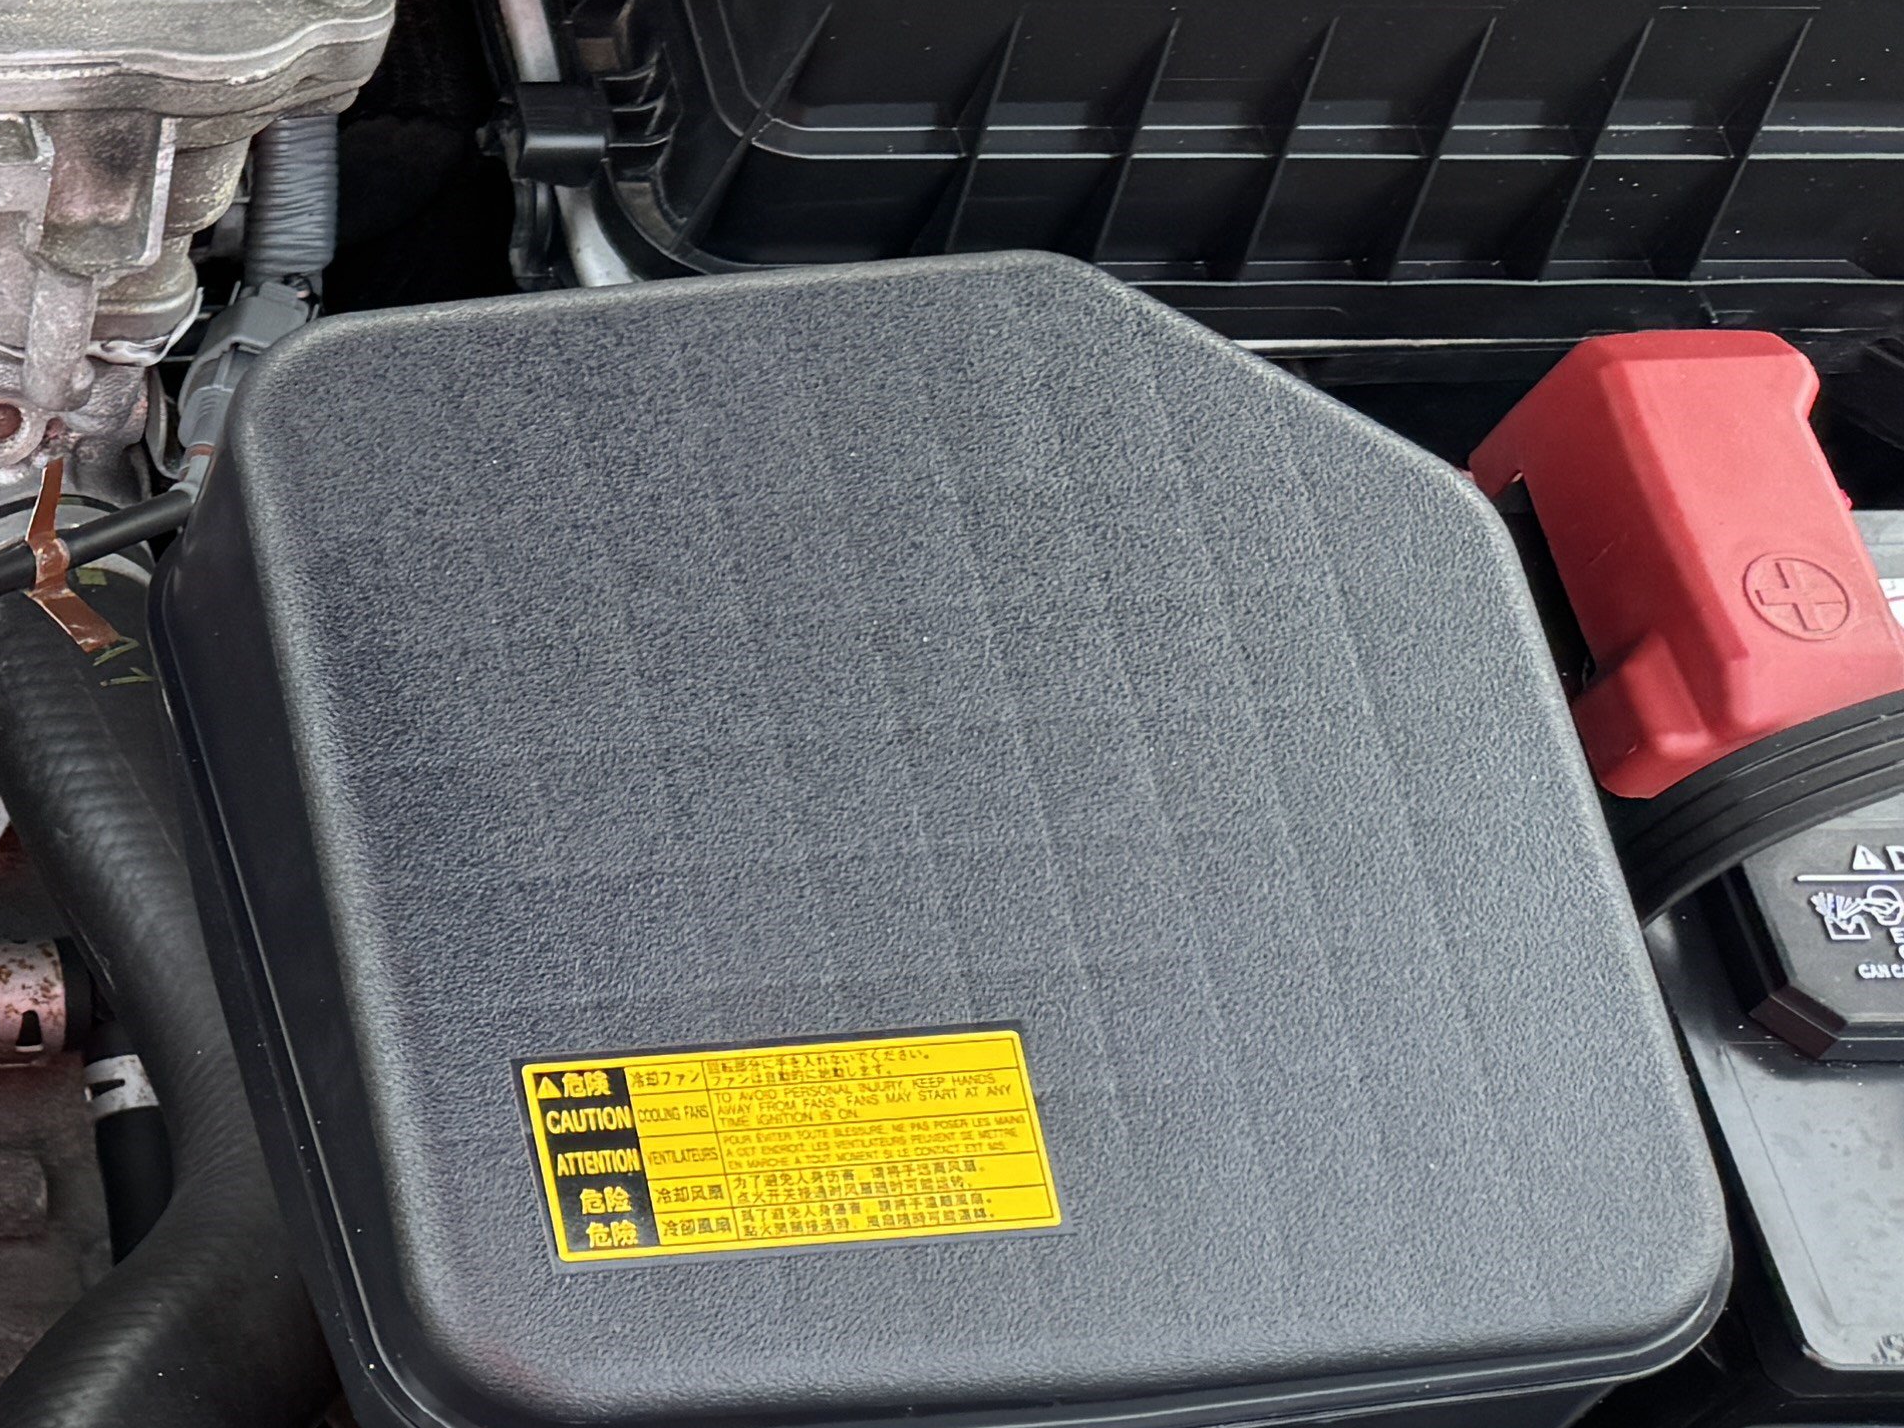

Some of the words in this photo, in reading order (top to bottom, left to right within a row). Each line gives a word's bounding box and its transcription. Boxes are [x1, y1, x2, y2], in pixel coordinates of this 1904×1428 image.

[562, 1070, 611, 1097] 危険
[715, 1092, 732, 1103] TO
[739, 1089, 777, 1102] AVOID
[783, 1083, 853, 1098] PERSONAL
[912, 1076, 946, 1089] KEEP
[951, 1072, 996, 1086] HANDS
[637, 1107, 681, 1123] COOLING
[683, 1105, 709, 1119] FANS
[718, 1103, 752, 1115] AWAY
[758, 1100, 796, 1113] FROM
[885, 1091, 912, 1103] MAY
[918, 1088, 959, 1101] START
[965, 1086, 979, 1098] AT
[986, 1084, 1012, 1097] ANY
[546, 1105, 633, 1134] CAUTION
[756, 1111, 814, 1125] IGNITION
[820, 1109, 832, 1121] IS
[556, 1147, 641, 1177] ATTENTION
[646, 1146, 718, 1165] VENTILATEURS
[580, 1186, 632, 1215] 危险
